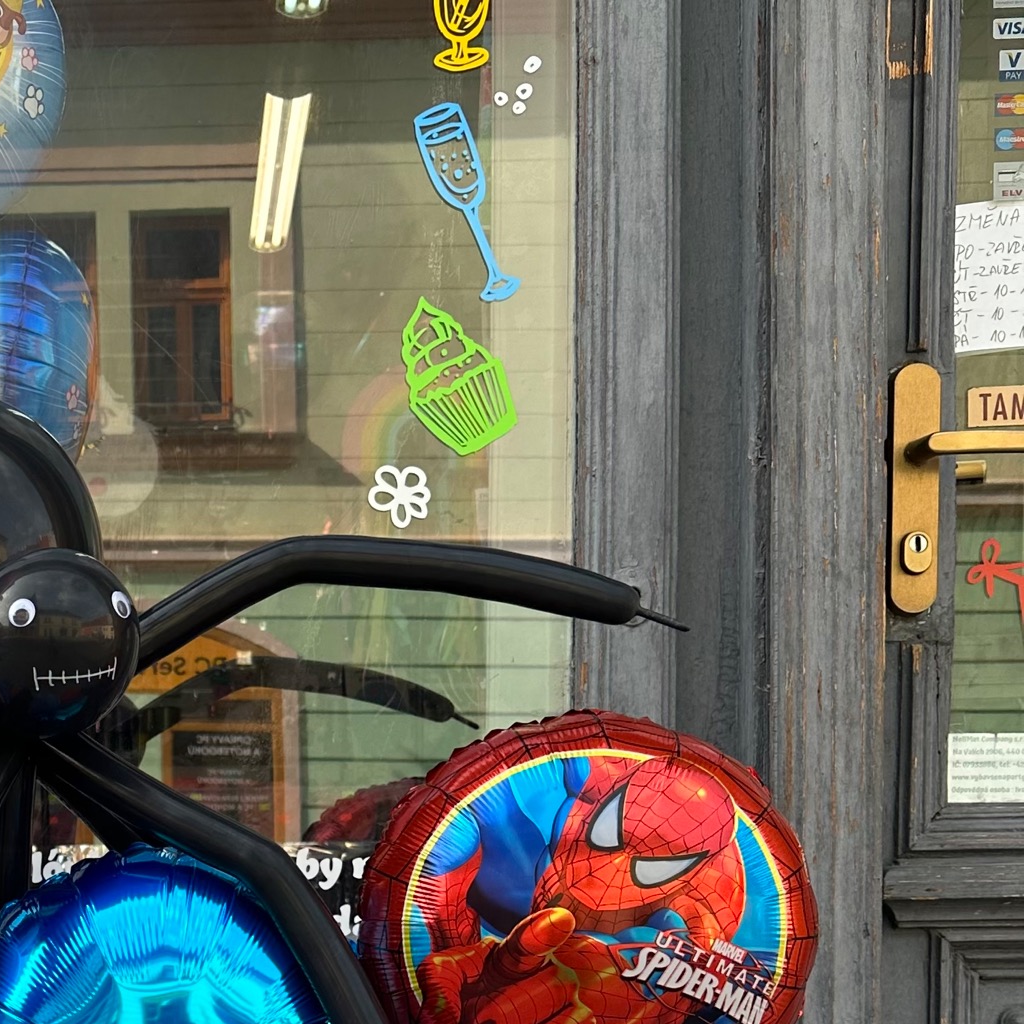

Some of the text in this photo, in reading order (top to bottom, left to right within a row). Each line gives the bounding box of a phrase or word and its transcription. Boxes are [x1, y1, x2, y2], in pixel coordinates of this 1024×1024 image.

[1005, 71, 1022, 80] PAY
[1002, 189, 1023, 198] ELV
[955, 205, 1020, 232] ZMĚNA
[655, 931, 776, 998] ULTIMATE
[712, 937, 749, 965] MARVEL
